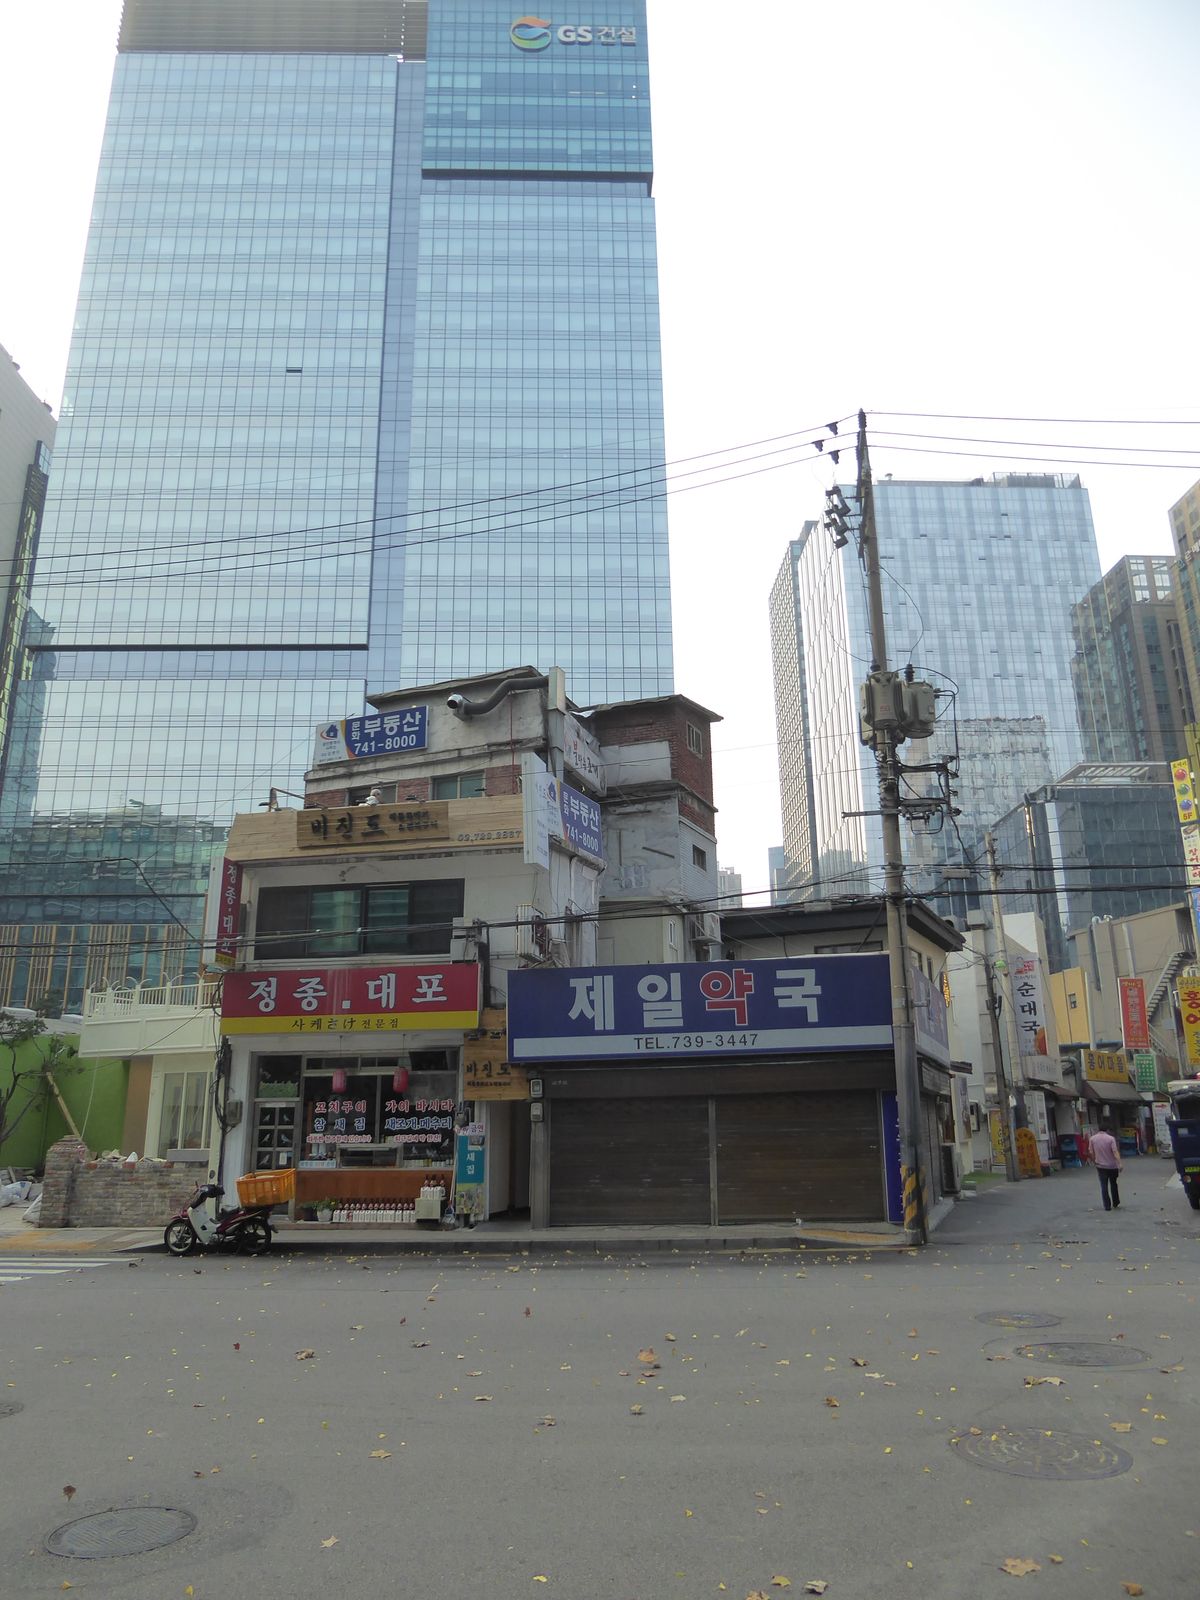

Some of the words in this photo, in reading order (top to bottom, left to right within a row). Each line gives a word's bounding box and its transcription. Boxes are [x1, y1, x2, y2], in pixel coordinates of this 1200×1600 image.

[557, 25, 593, 45] GS
[597, 26, 636, 46] 건설
[364, 711, 421, 738] 부동산
[354, 734, 416, 754] 741-8000
[570, 795, 599, 832] 부동산
[1183, 811, 1193, 820] 5F
[566, 823, 599, 852] 741-8000
[568, 968, 822, 1030] 제일약국
[1016, 980, 1041, 1036] 순대국
[634, 1033, 759, 1050] TEL.739-3447
